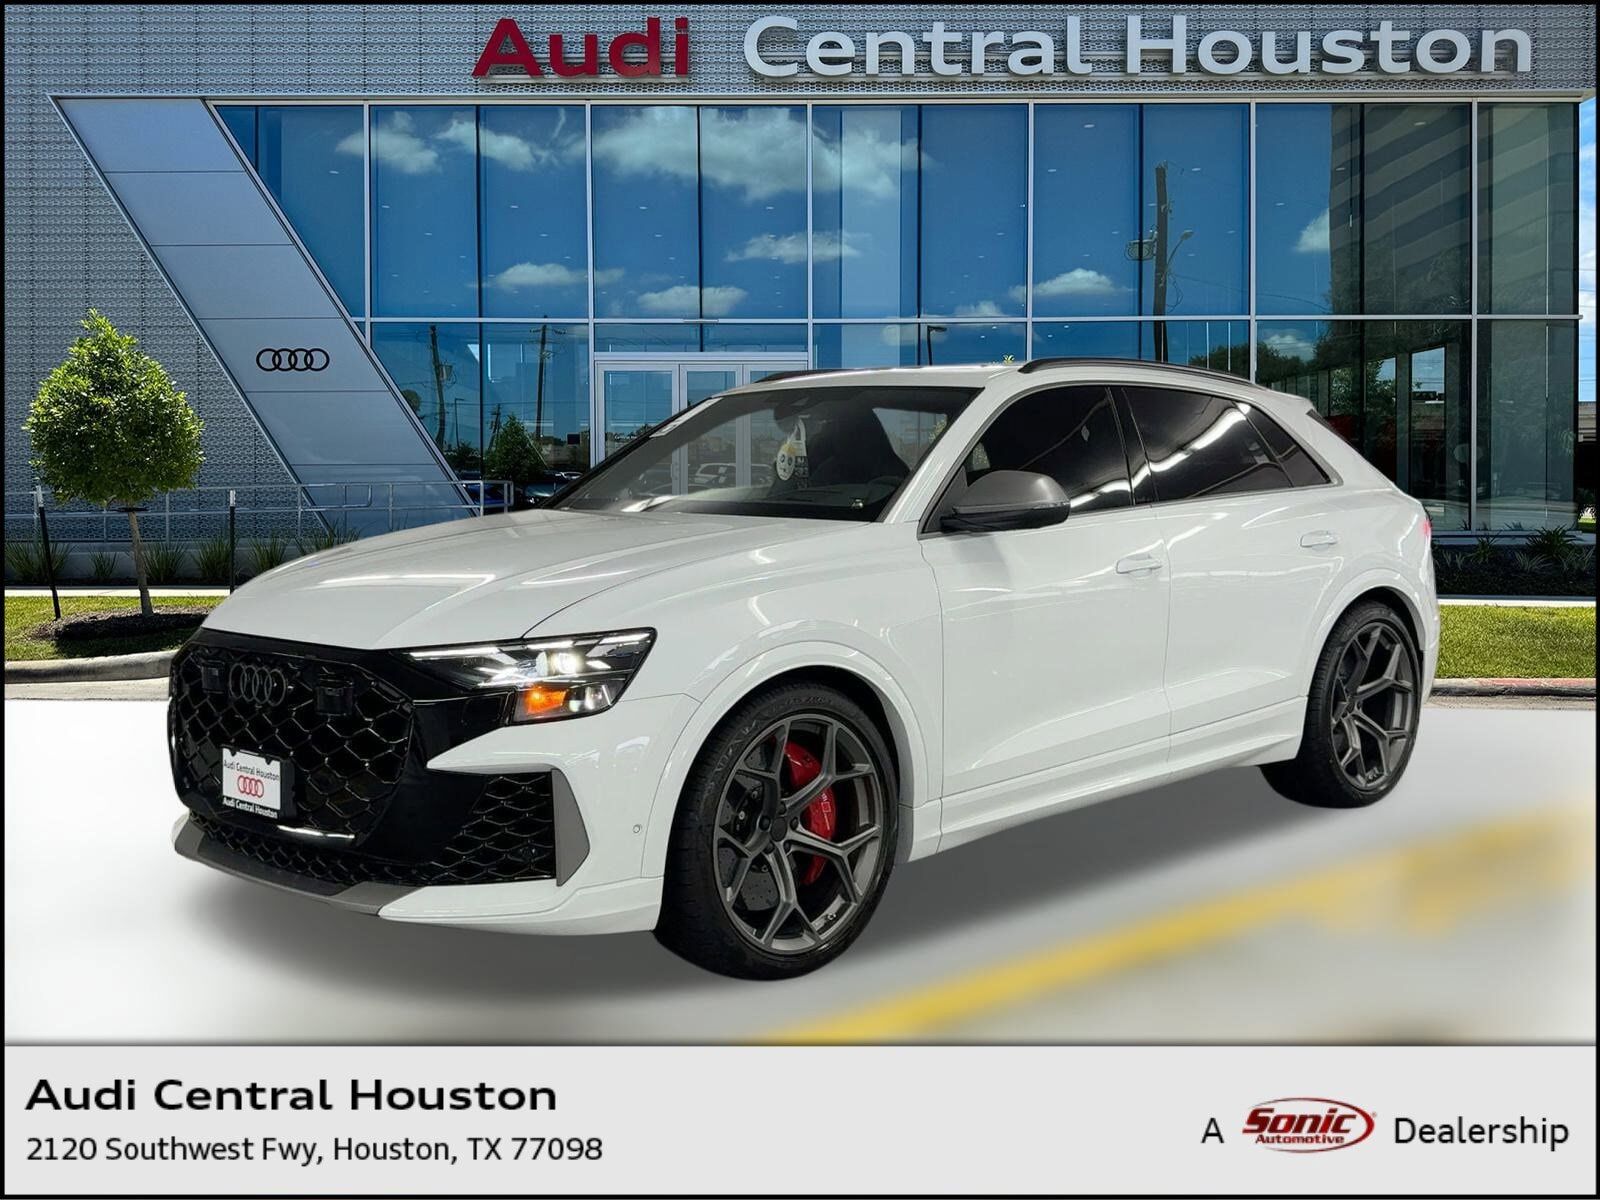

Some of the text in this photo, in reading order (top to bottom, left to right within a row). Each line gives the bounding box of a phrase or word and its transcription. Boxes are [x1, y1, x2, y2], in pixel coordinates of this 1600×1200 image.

[472, 15, 1532, 78] Audi Central Houston
[223, 760, 280, 781] Audi Central Houston
[223, 797, 278, 819] Audi Central Houston
